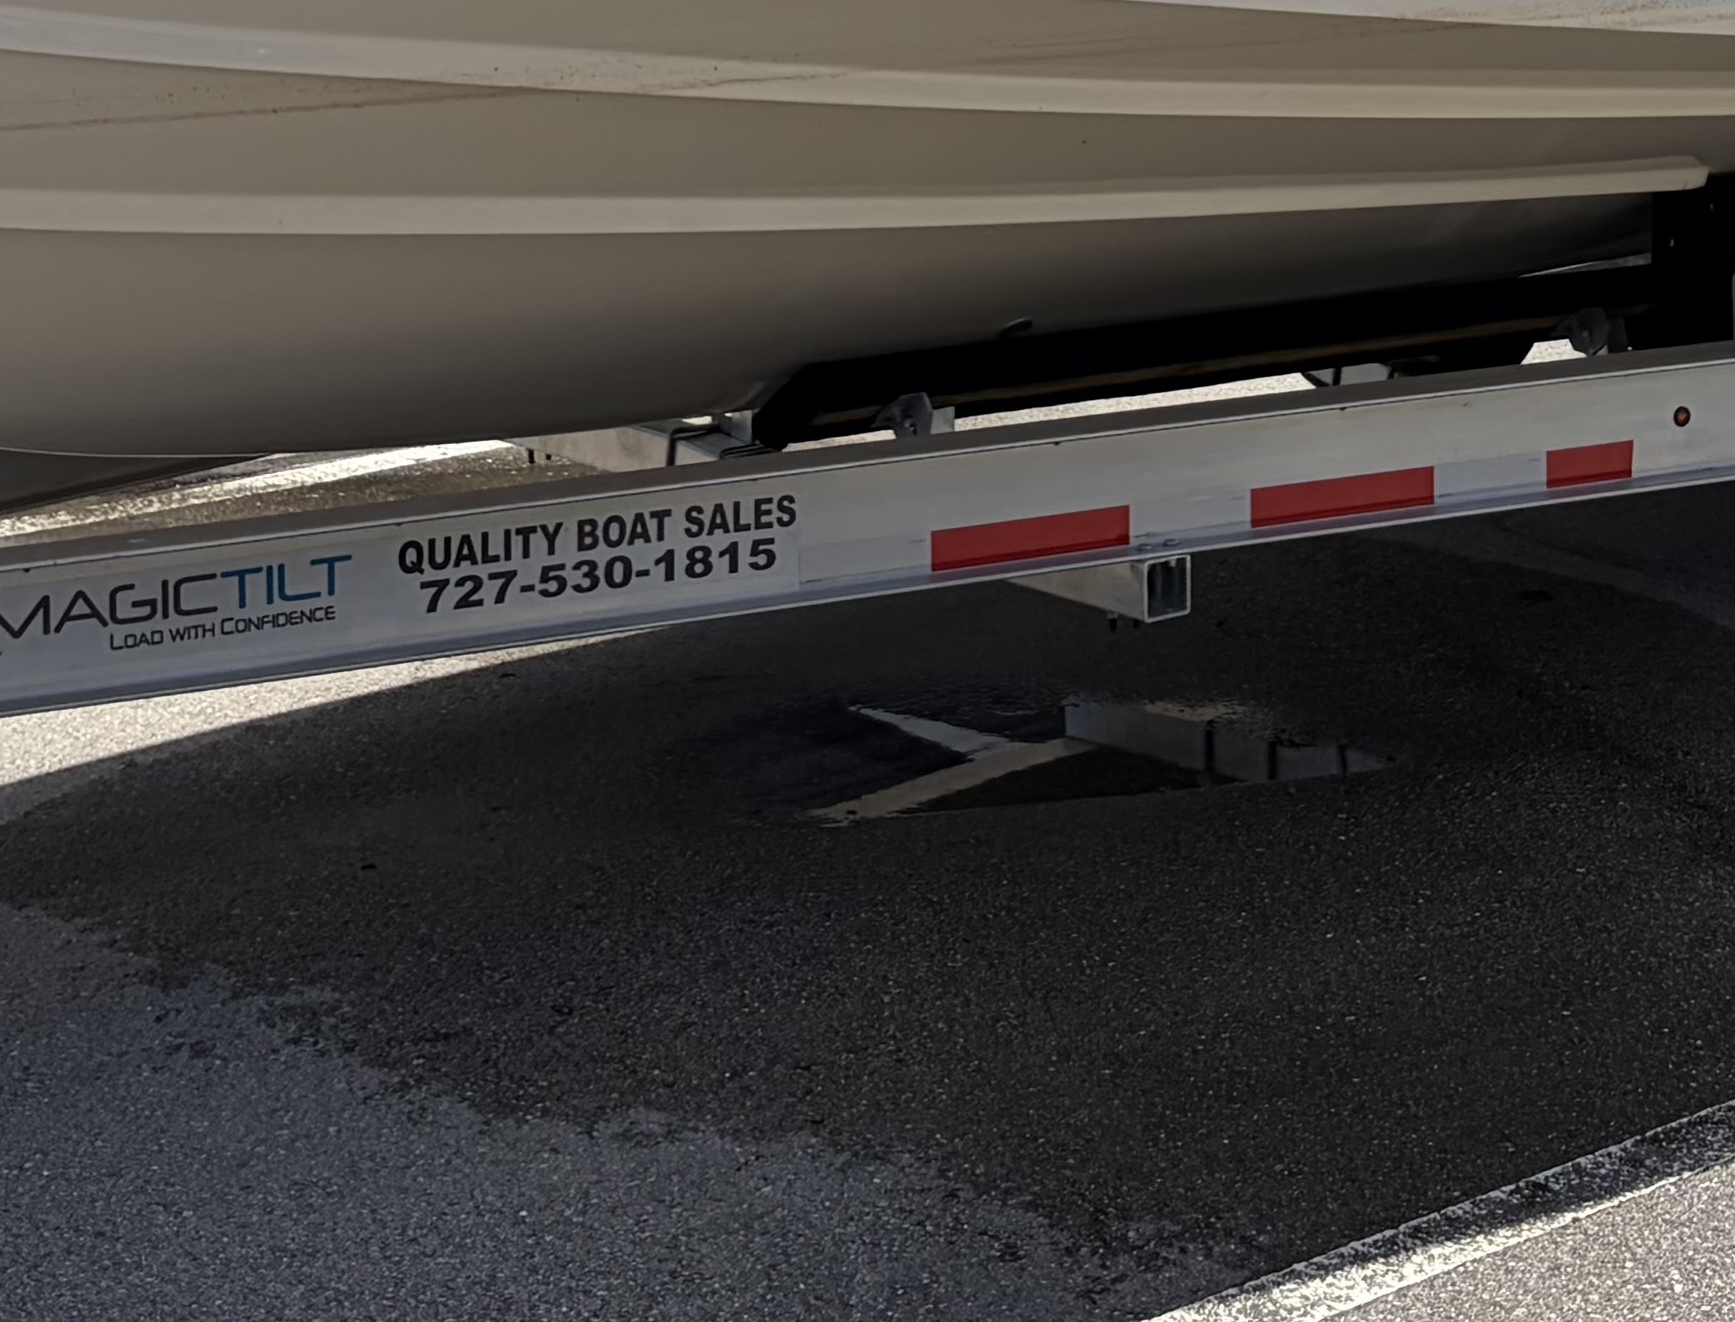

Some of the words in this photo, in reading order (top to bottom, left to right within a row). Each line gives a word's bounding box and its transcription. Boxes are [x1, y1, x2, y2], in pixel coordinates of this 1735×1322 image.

[397, 522, 564, 576] QUALITY
[576, 508, 672, 552] BOAT
[683, 494, 797, 538] SALES
[419, 537, 777, 614] 727-530-1815
[109, 629, 164, 651] LOAD
[169, 622, 216, 644] WITH
[221, 604, 337, 636] CONFIDENCE
